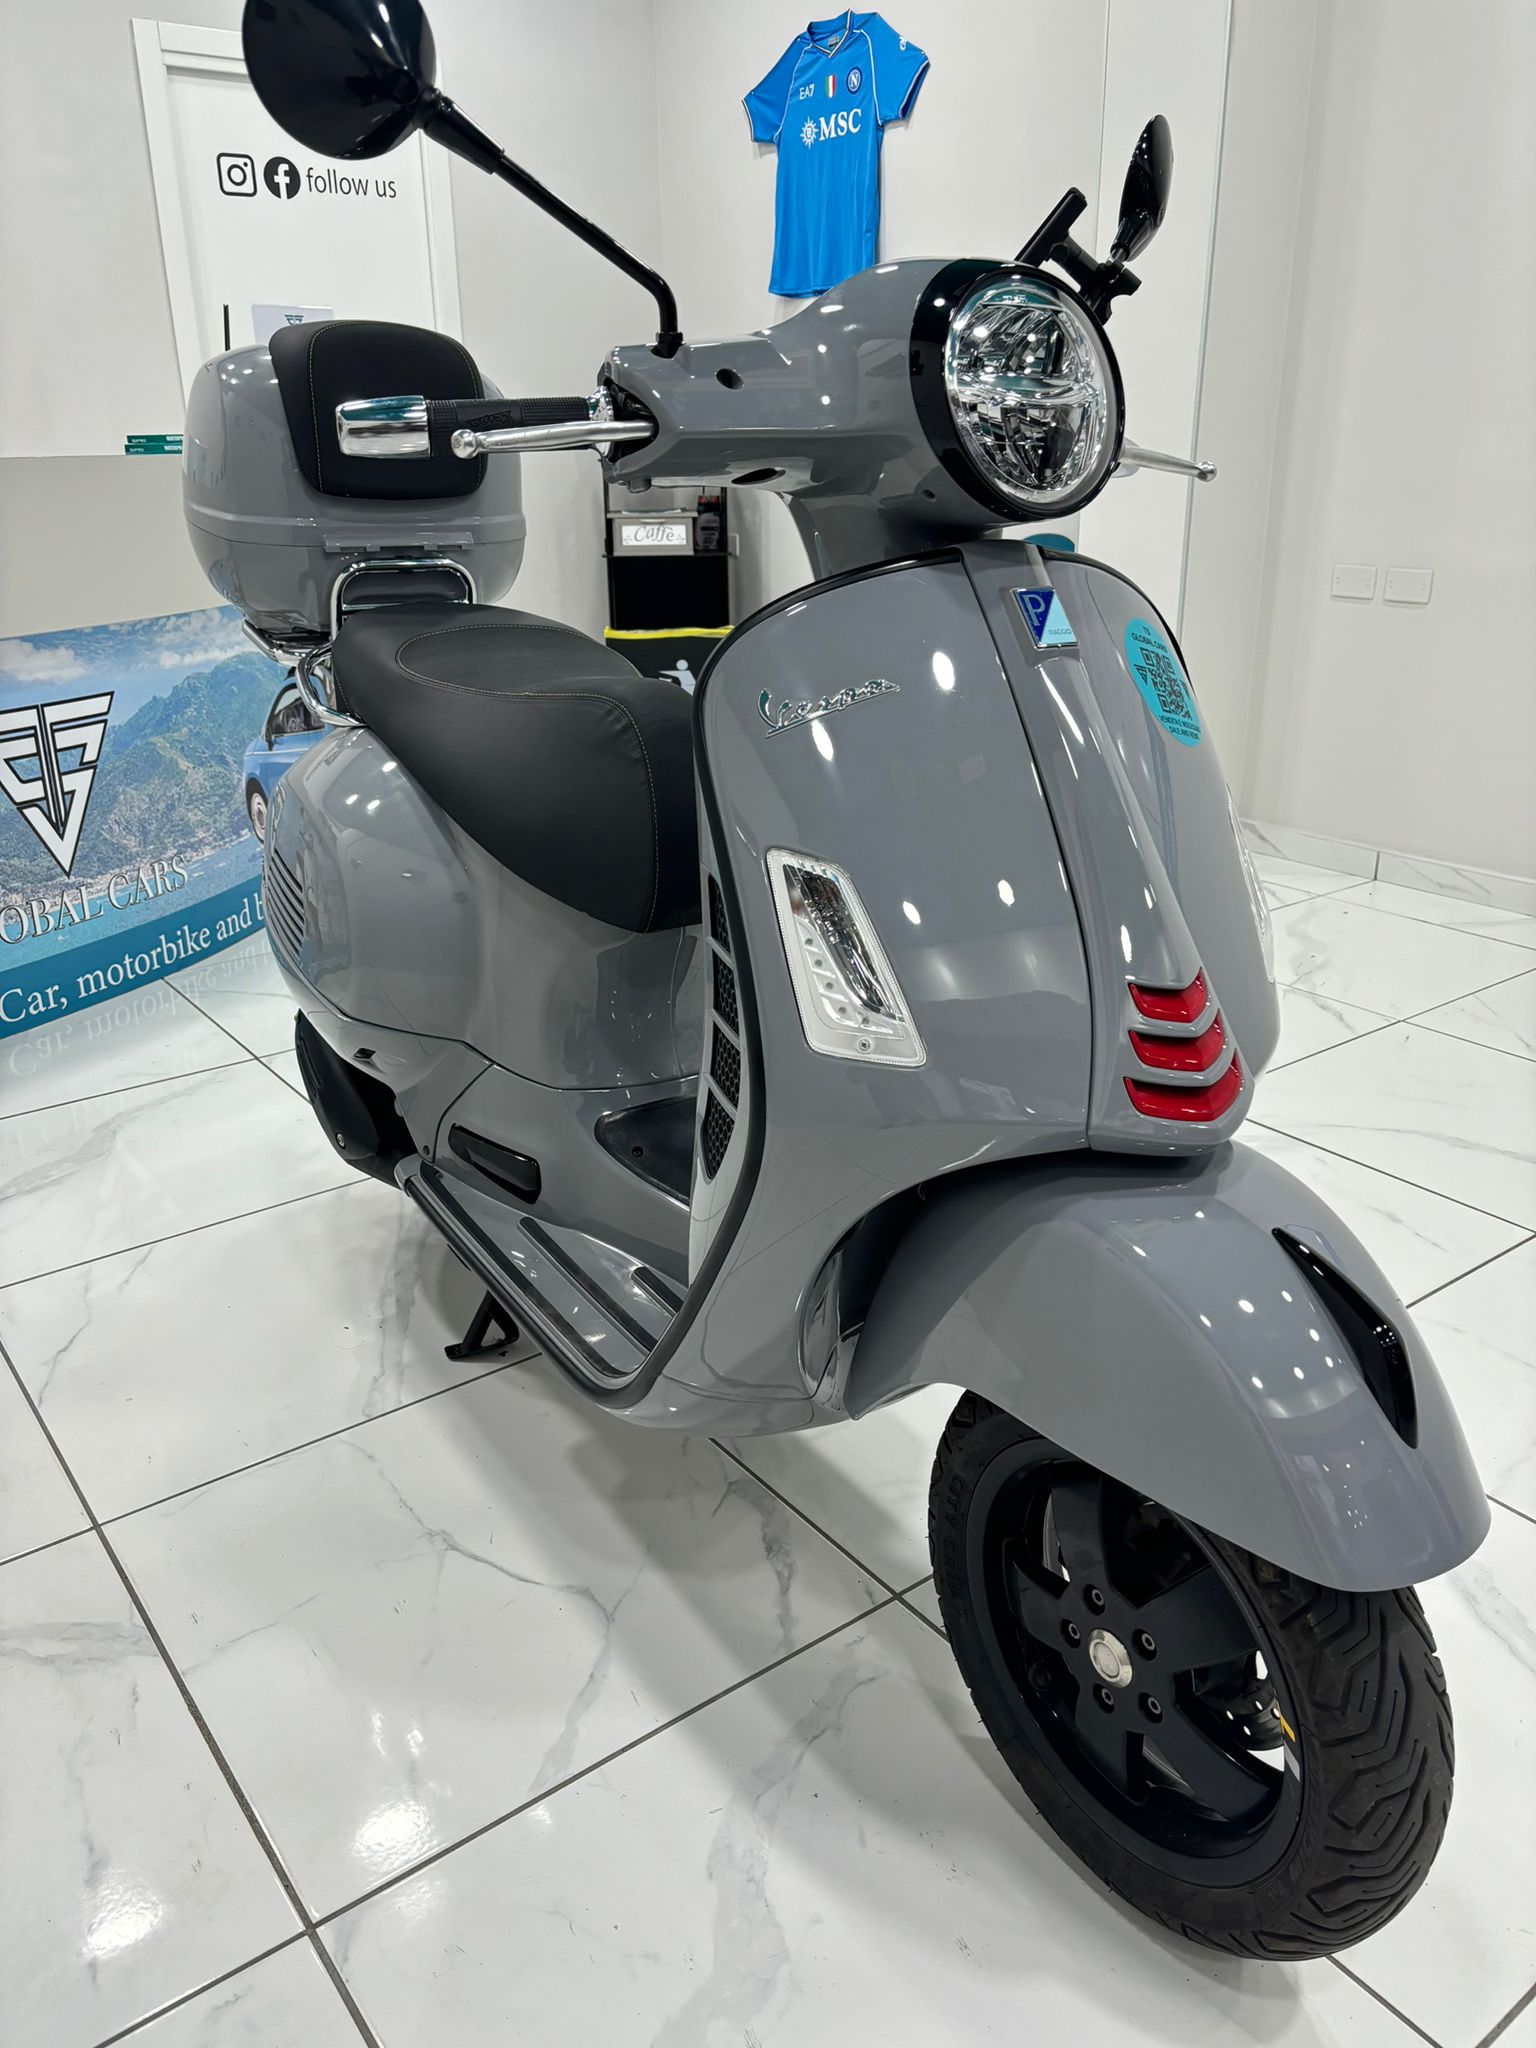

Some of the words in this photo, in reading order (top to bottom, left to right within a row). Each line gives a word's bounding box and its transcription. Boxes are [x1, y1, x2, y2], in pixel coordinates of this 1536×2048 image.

[799, 83, 815, 100] EA7
[819, 108, 862, 141] MSC
[306, 167, 369, 196] follow
[375, 180, 397, 199] us
[1021, 594, 1046, 627] P
[758, 679, 901, 739] Vespa
[107, 855, 188, 910] CARS
[0, 984, 68, 1022] Car,
[77, 925, 211, 998] motorbike
[216, 897, 252, 940] and
